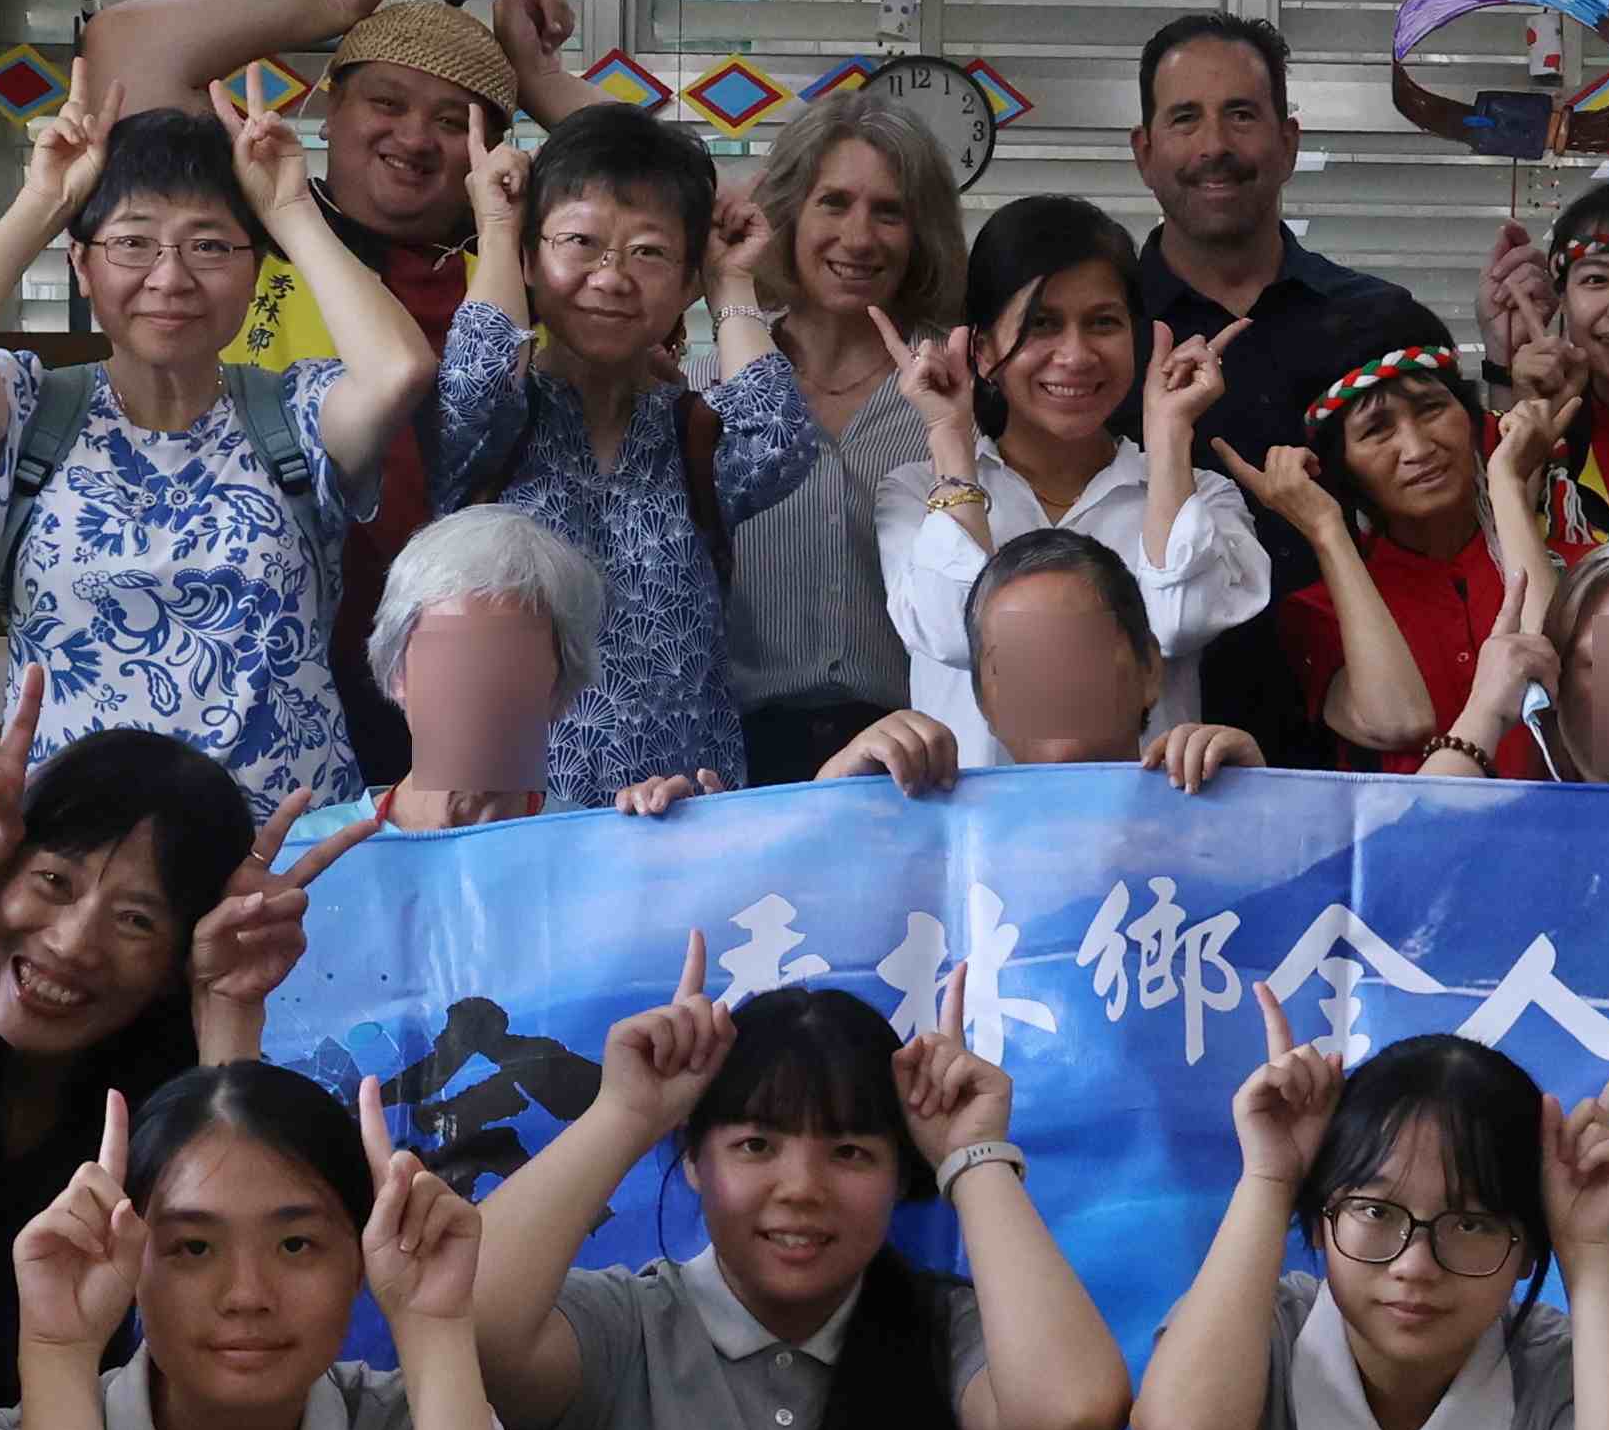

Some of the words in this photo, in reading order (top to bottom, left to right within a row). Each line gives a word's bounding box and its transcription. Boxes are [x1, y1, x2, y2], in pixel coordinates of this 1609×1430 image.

[889, 75, 903, 97] 11
[911, 68, 931, 89] 12
[944, 73, 951, 95] 1
[962, 93, 975, 114] 2
[973, 120, 984, 142] 3
[961, 146, 973, 168] 4
[247, 274, 295, 367] 秀林鄉
